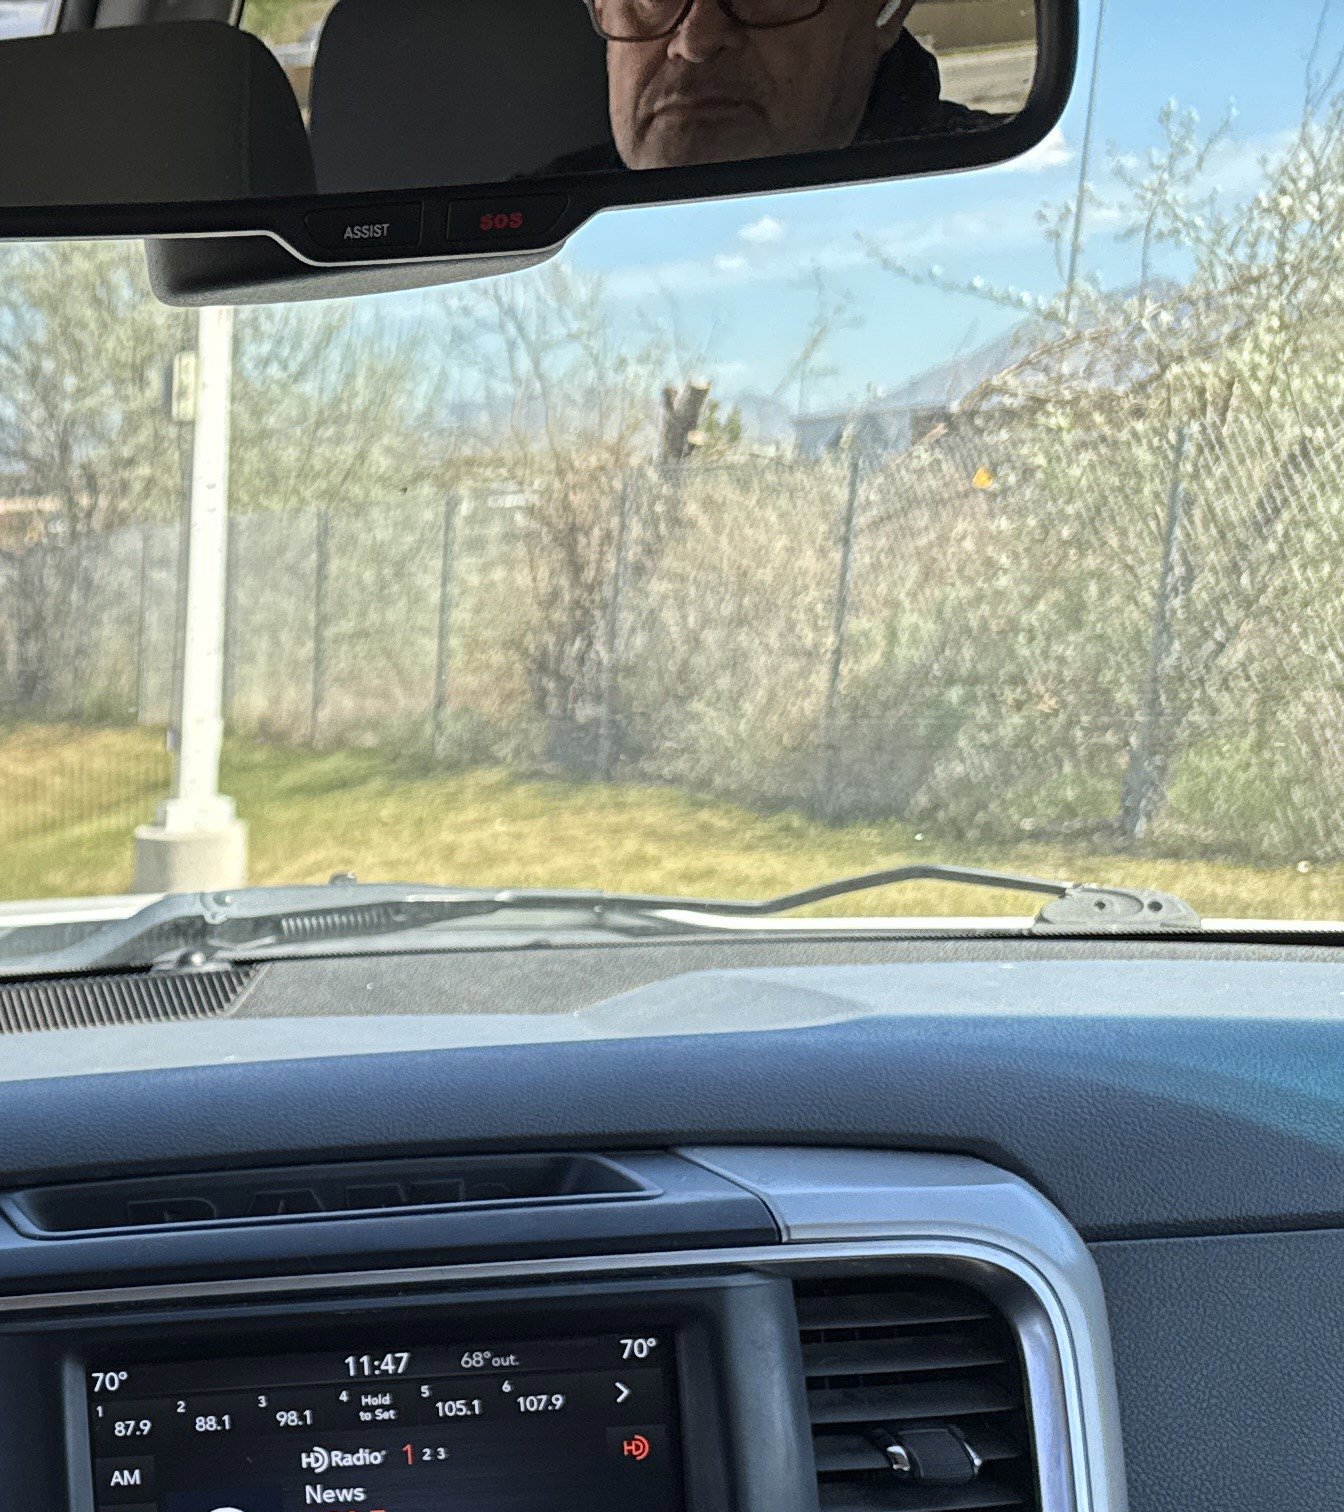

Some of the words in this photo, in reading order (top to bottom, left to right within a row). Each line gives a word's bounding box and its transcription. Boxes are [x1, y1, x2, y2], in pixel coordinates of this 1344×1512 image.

[343, 223, 390, 240] ASSIST
[480, 212, 523, 231] SOS
[345, 1352, 410, 1377] 11:47
[339, 1391, 349, 1403] 4
[361, 1393, 392, 1407] Hold
[421, 1385, 430, 1398] 5
[435, 1400, 481, 1418] 105.1
[502, 1380, 511, 1393] 6
[517, 1395, 565, 1413] 107.9
[96, 1406, 103, 1417] 1
[114, 1420, 152, 1436] 87.9
[177, 1401, 186, 1413] 2
[195, 1415, 232, 1431] 88.1
[258, 1396, 267, 1408] 3
[276, 1410, 312, 1427] 98.1
[359, 1410, 373, 1421] to
[374, 1408, 397, 1421] Set
[330, 1449, 383, 1467] Radio
[402, 1443, 413, 1465] 1
[422, 1448, 432, 1461] 2
[436, 1447, 447, 1460] 3
[110, 1469, 141, 1487] AM
[305, 1484, 366, 1505] News
